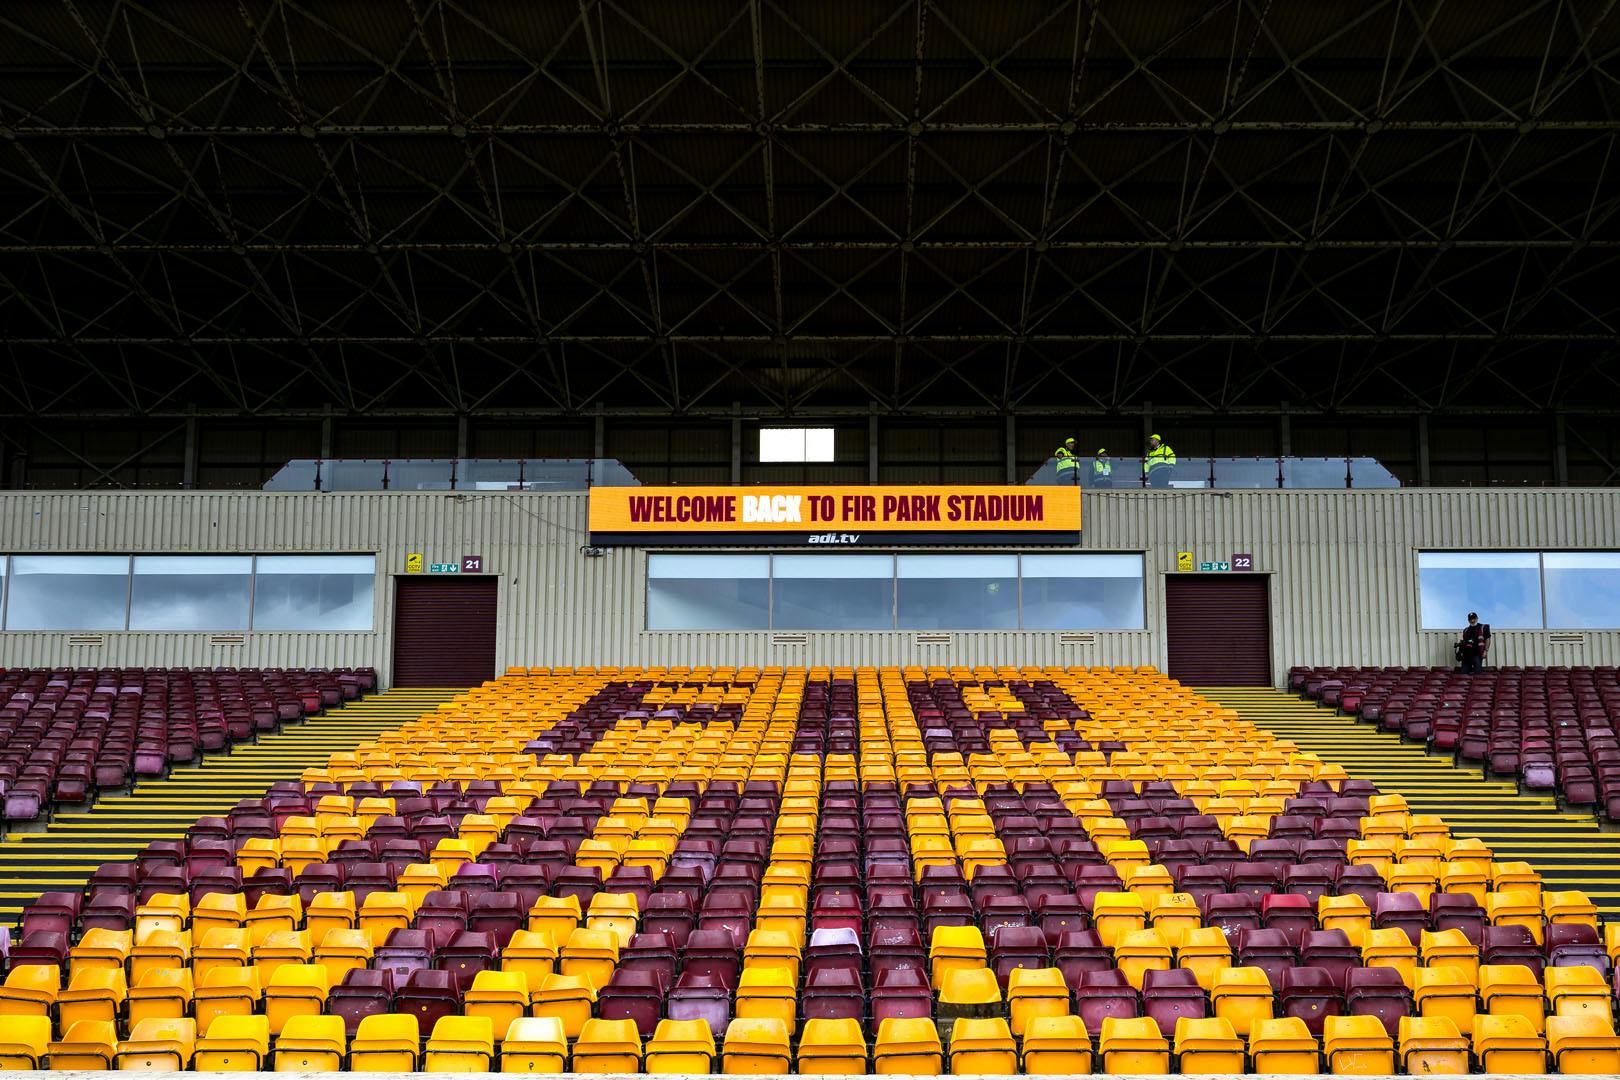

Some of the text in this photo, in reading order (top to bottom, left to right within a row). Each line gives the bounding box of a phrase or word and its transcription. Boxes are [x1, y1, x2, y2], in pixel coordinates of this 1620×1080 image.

[629, 494, 1044, 523] WELCOME BACK TO FIR PARK STADIUM
[808, 532, 860, 544] adi.tv
[465, 560, 479, 569] 21
[1235, 558, 1250, 567] 22
